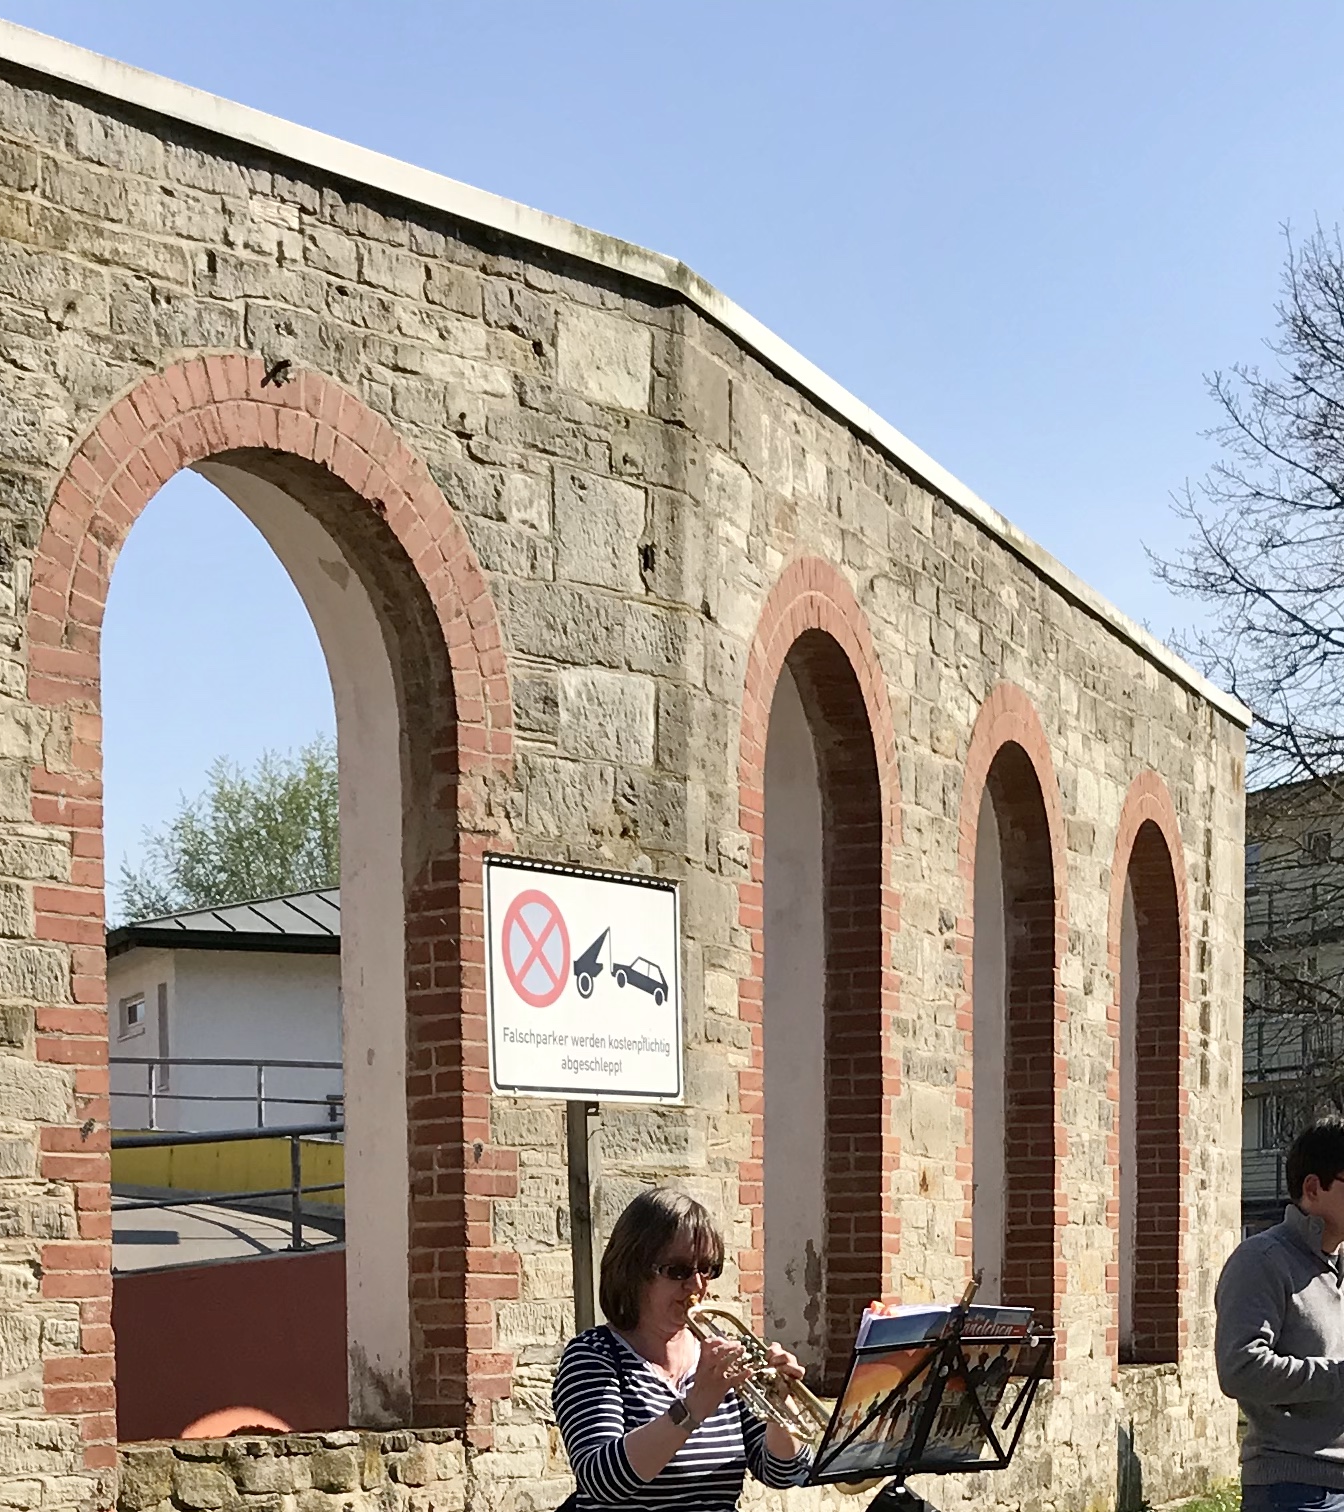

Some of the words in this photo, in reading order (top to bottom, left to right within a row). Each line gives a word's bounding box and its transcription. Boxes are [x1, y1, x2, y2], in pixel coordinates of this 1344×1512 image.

[503, 1027, 569, 1048] Falschparker
[570, 1033, 606, 1049] werden
[608, 1035, 671, 1057] kostenpflichtig
[561, 1055, 623, 1076] abgeschleppt
